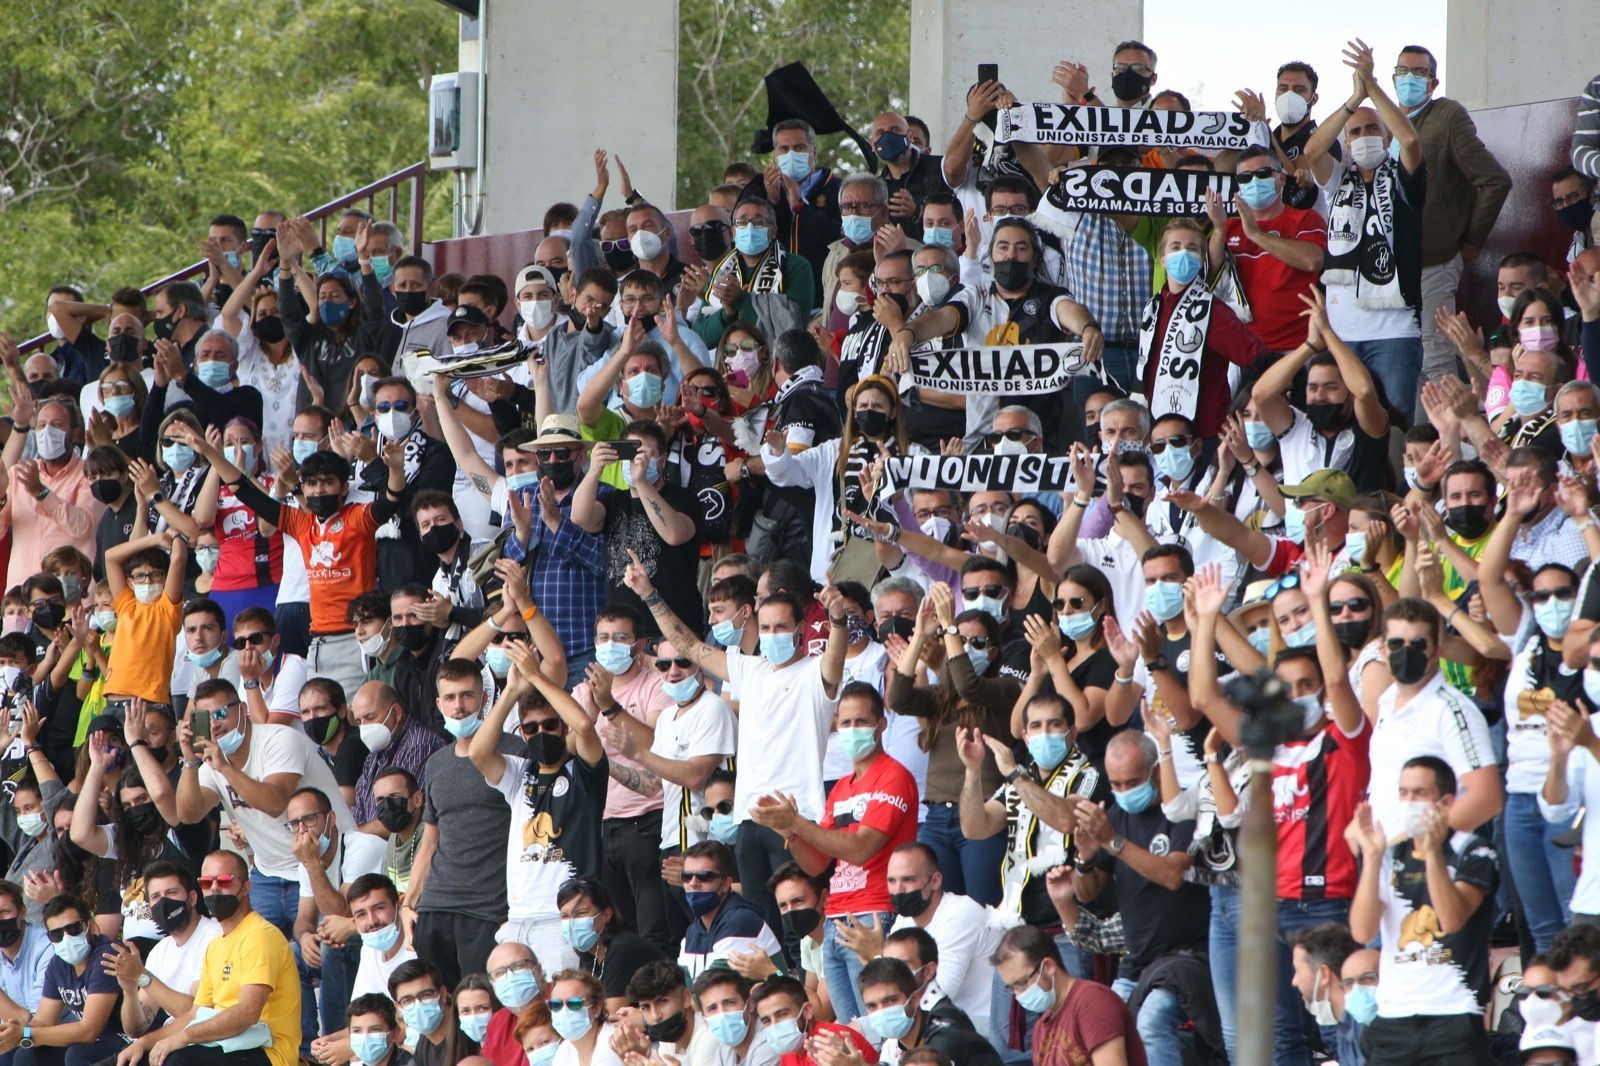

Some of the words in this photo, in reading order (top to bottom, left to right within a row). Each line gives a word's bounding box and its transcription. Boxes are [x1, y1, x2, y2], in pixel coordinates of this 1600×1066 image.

[1036, 130, 1125, 143] UNIONISTAS
[1132, 133, 1149, 144] DE
[1155, 134, 1249, 148] SALAMANCA
[1159, 288, 1198, 376] SALAMANCA
[914, 375, 999, 392] UNIONISTAS
[1005, 380, 1021, 392] DE
[1026, 375, 1069, 391] SALAM
